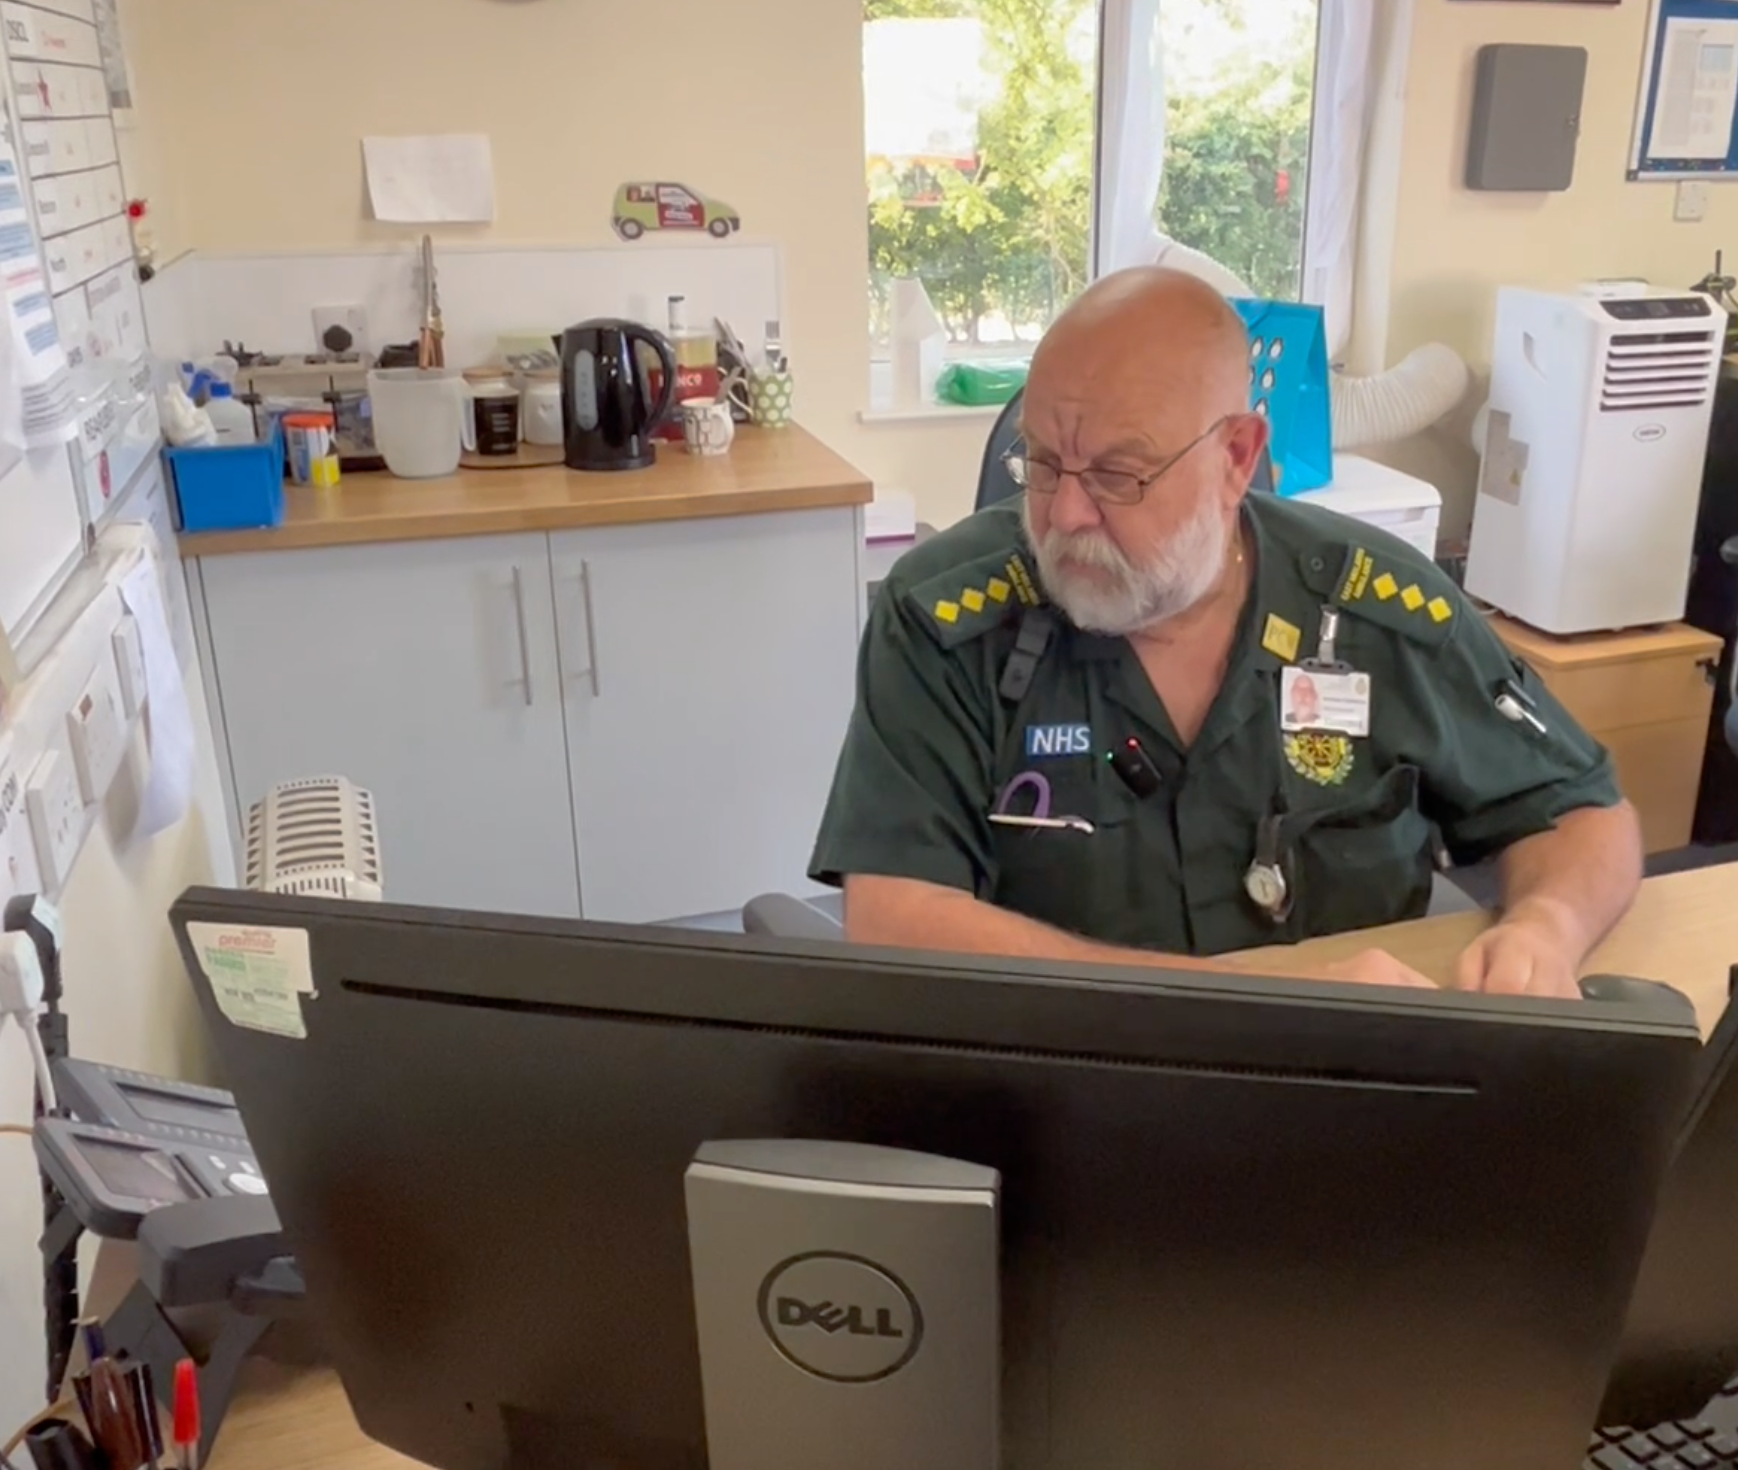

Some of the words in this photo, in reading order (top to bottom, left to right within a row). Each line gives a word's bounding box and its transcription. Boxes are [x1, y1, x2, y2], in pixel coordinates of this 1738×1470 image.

[1033, 727, 1090, 752] NHS
[218, 935, 277, 949] premier
[777, 1297, 903, 1338] DELL
